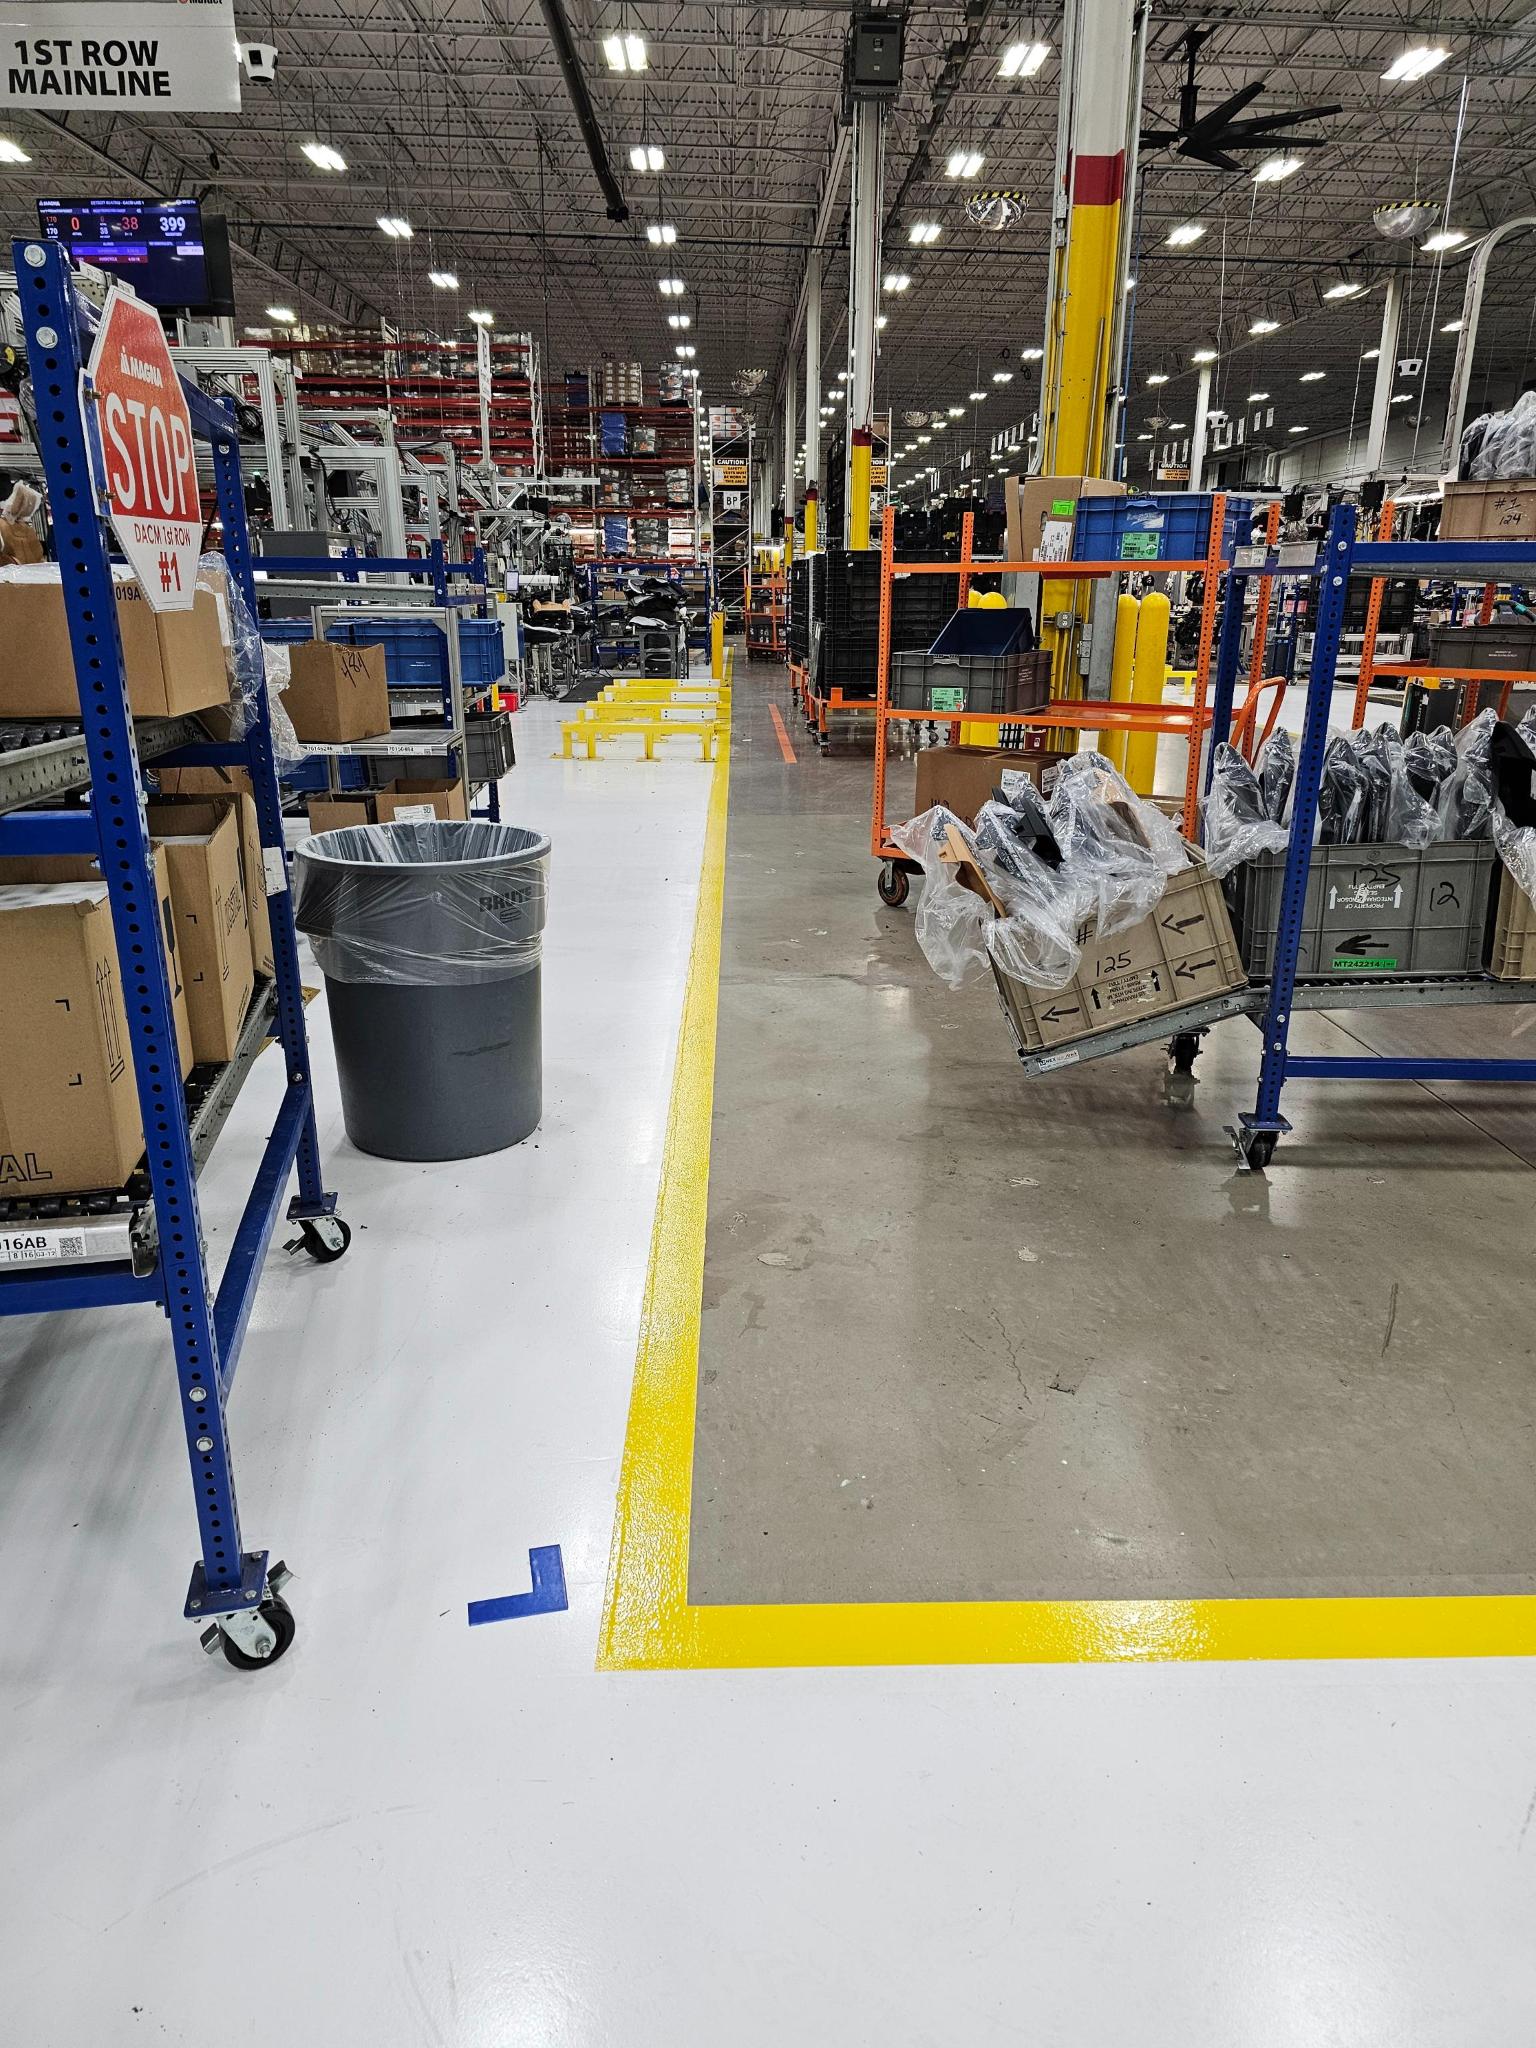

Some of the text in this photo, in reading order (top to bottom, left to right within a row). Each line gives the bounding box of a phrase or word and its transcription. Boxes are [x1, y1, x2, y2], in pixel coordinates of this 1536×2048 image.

[14, 39, 159, 67] 1ST ROW
[8, 69, 172, 97] MAINLINE
[46, 227, 59, 235] 170
[71, 217, 80, 231] 0
[159, 217, 186, 232] 399
[129, 356, 164, 389] MAGNA
[105, 392, 190, 515] STOP
[726, 496, 738, 506] BP
[1499, 513, 1522, 526] 124
[134, 523, 191, 546] DACM 1st ROW
[158, 551, 182, 593] #1
[1353, 865, 1401, 888] 125
[1429, 881, 1460, 912] 12
[1096, 950, 1132, 977] 125
